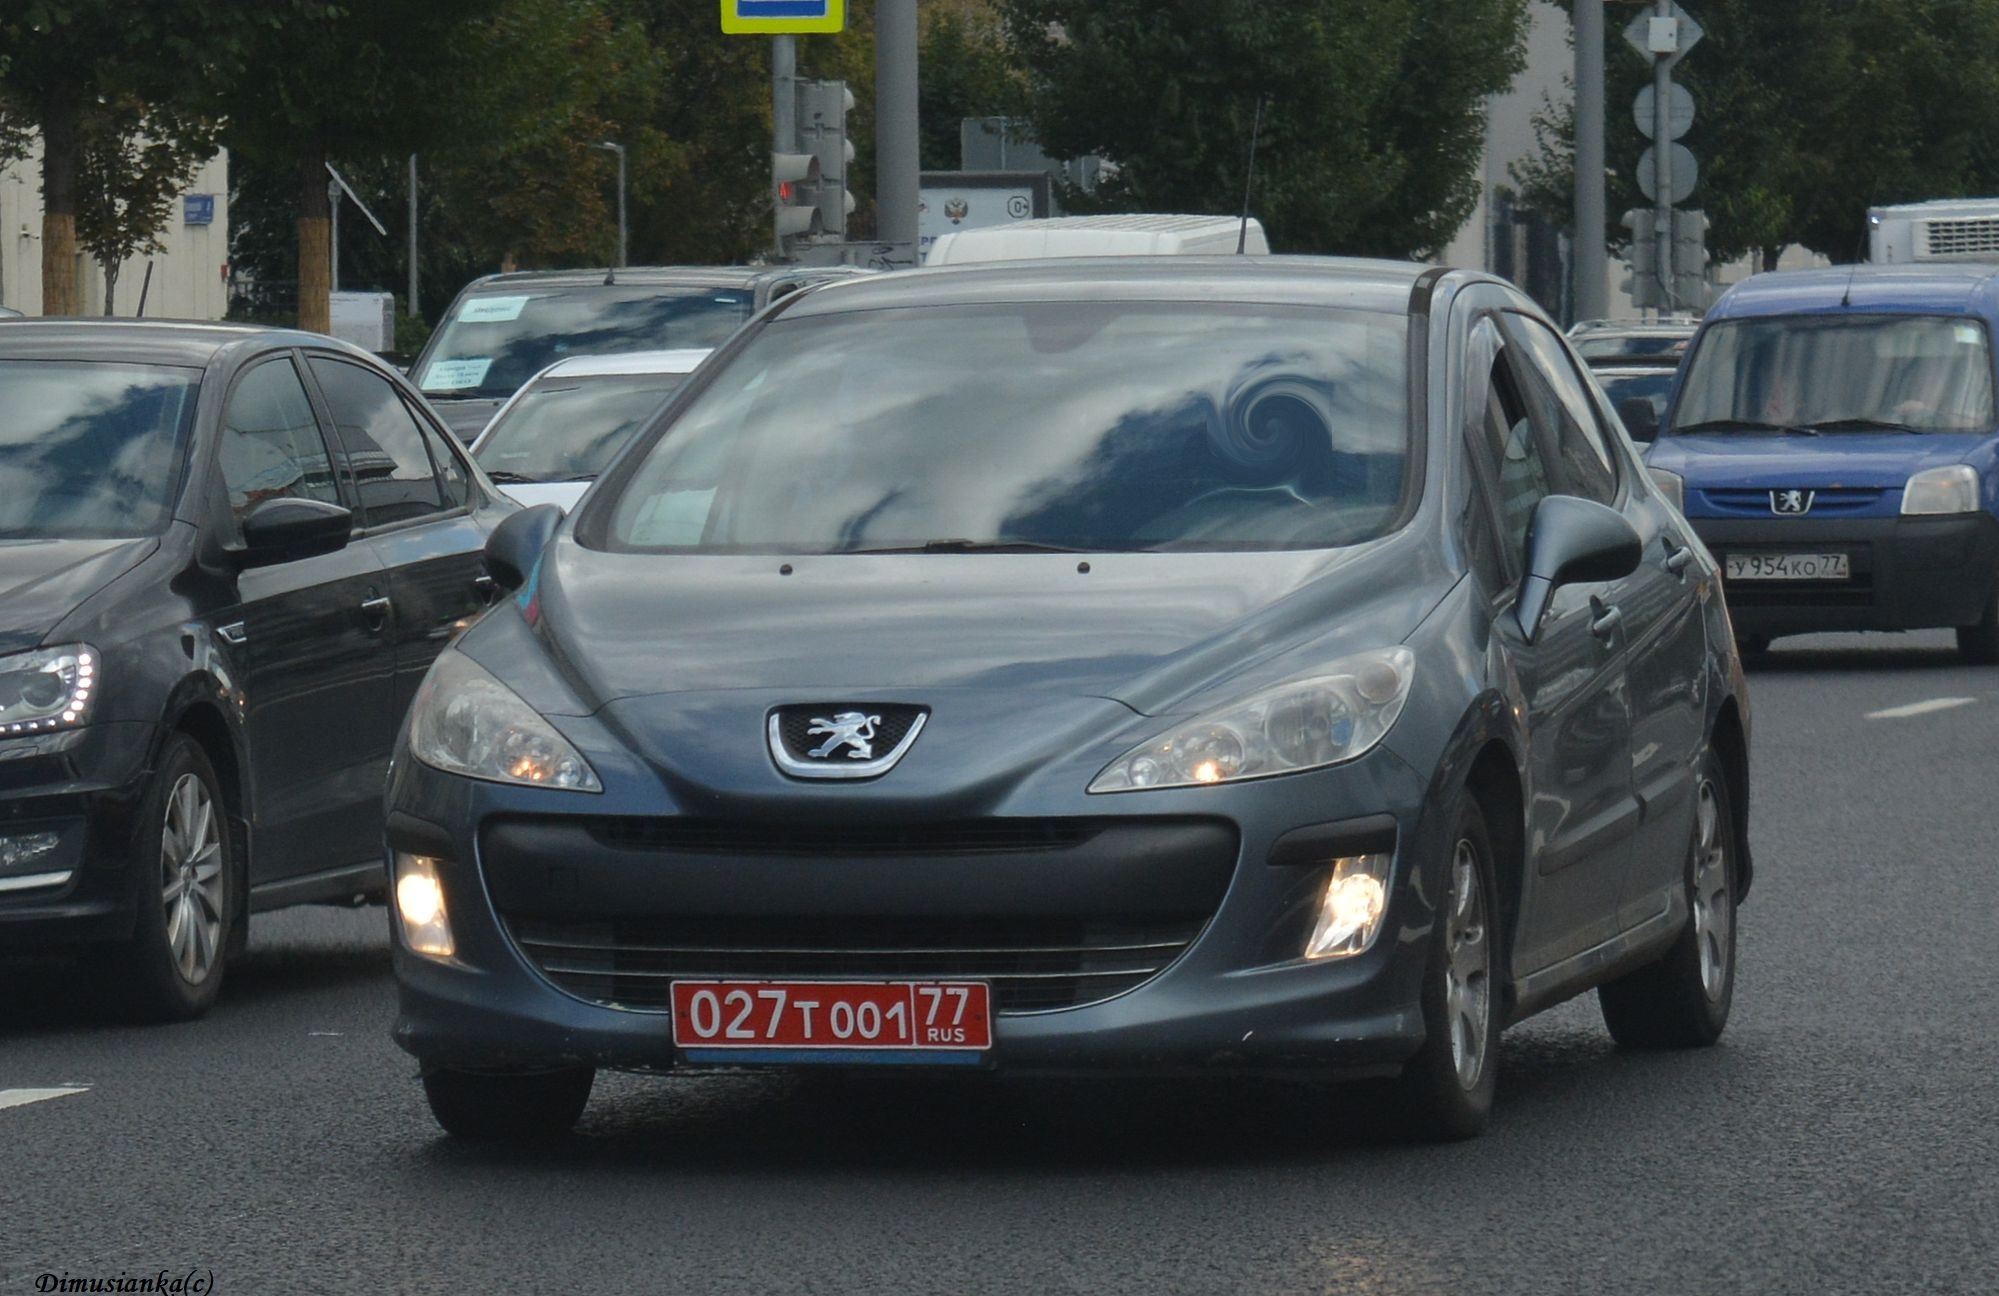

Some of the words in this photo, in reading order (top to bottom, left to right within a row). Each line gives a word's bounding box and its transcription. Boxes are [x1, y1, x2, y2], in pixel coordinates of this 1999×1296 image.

[1821, 556, 1840, 570] 77
[919, 988, 969, 1025] 77
[927, 1028, 966, 1043] RUS
